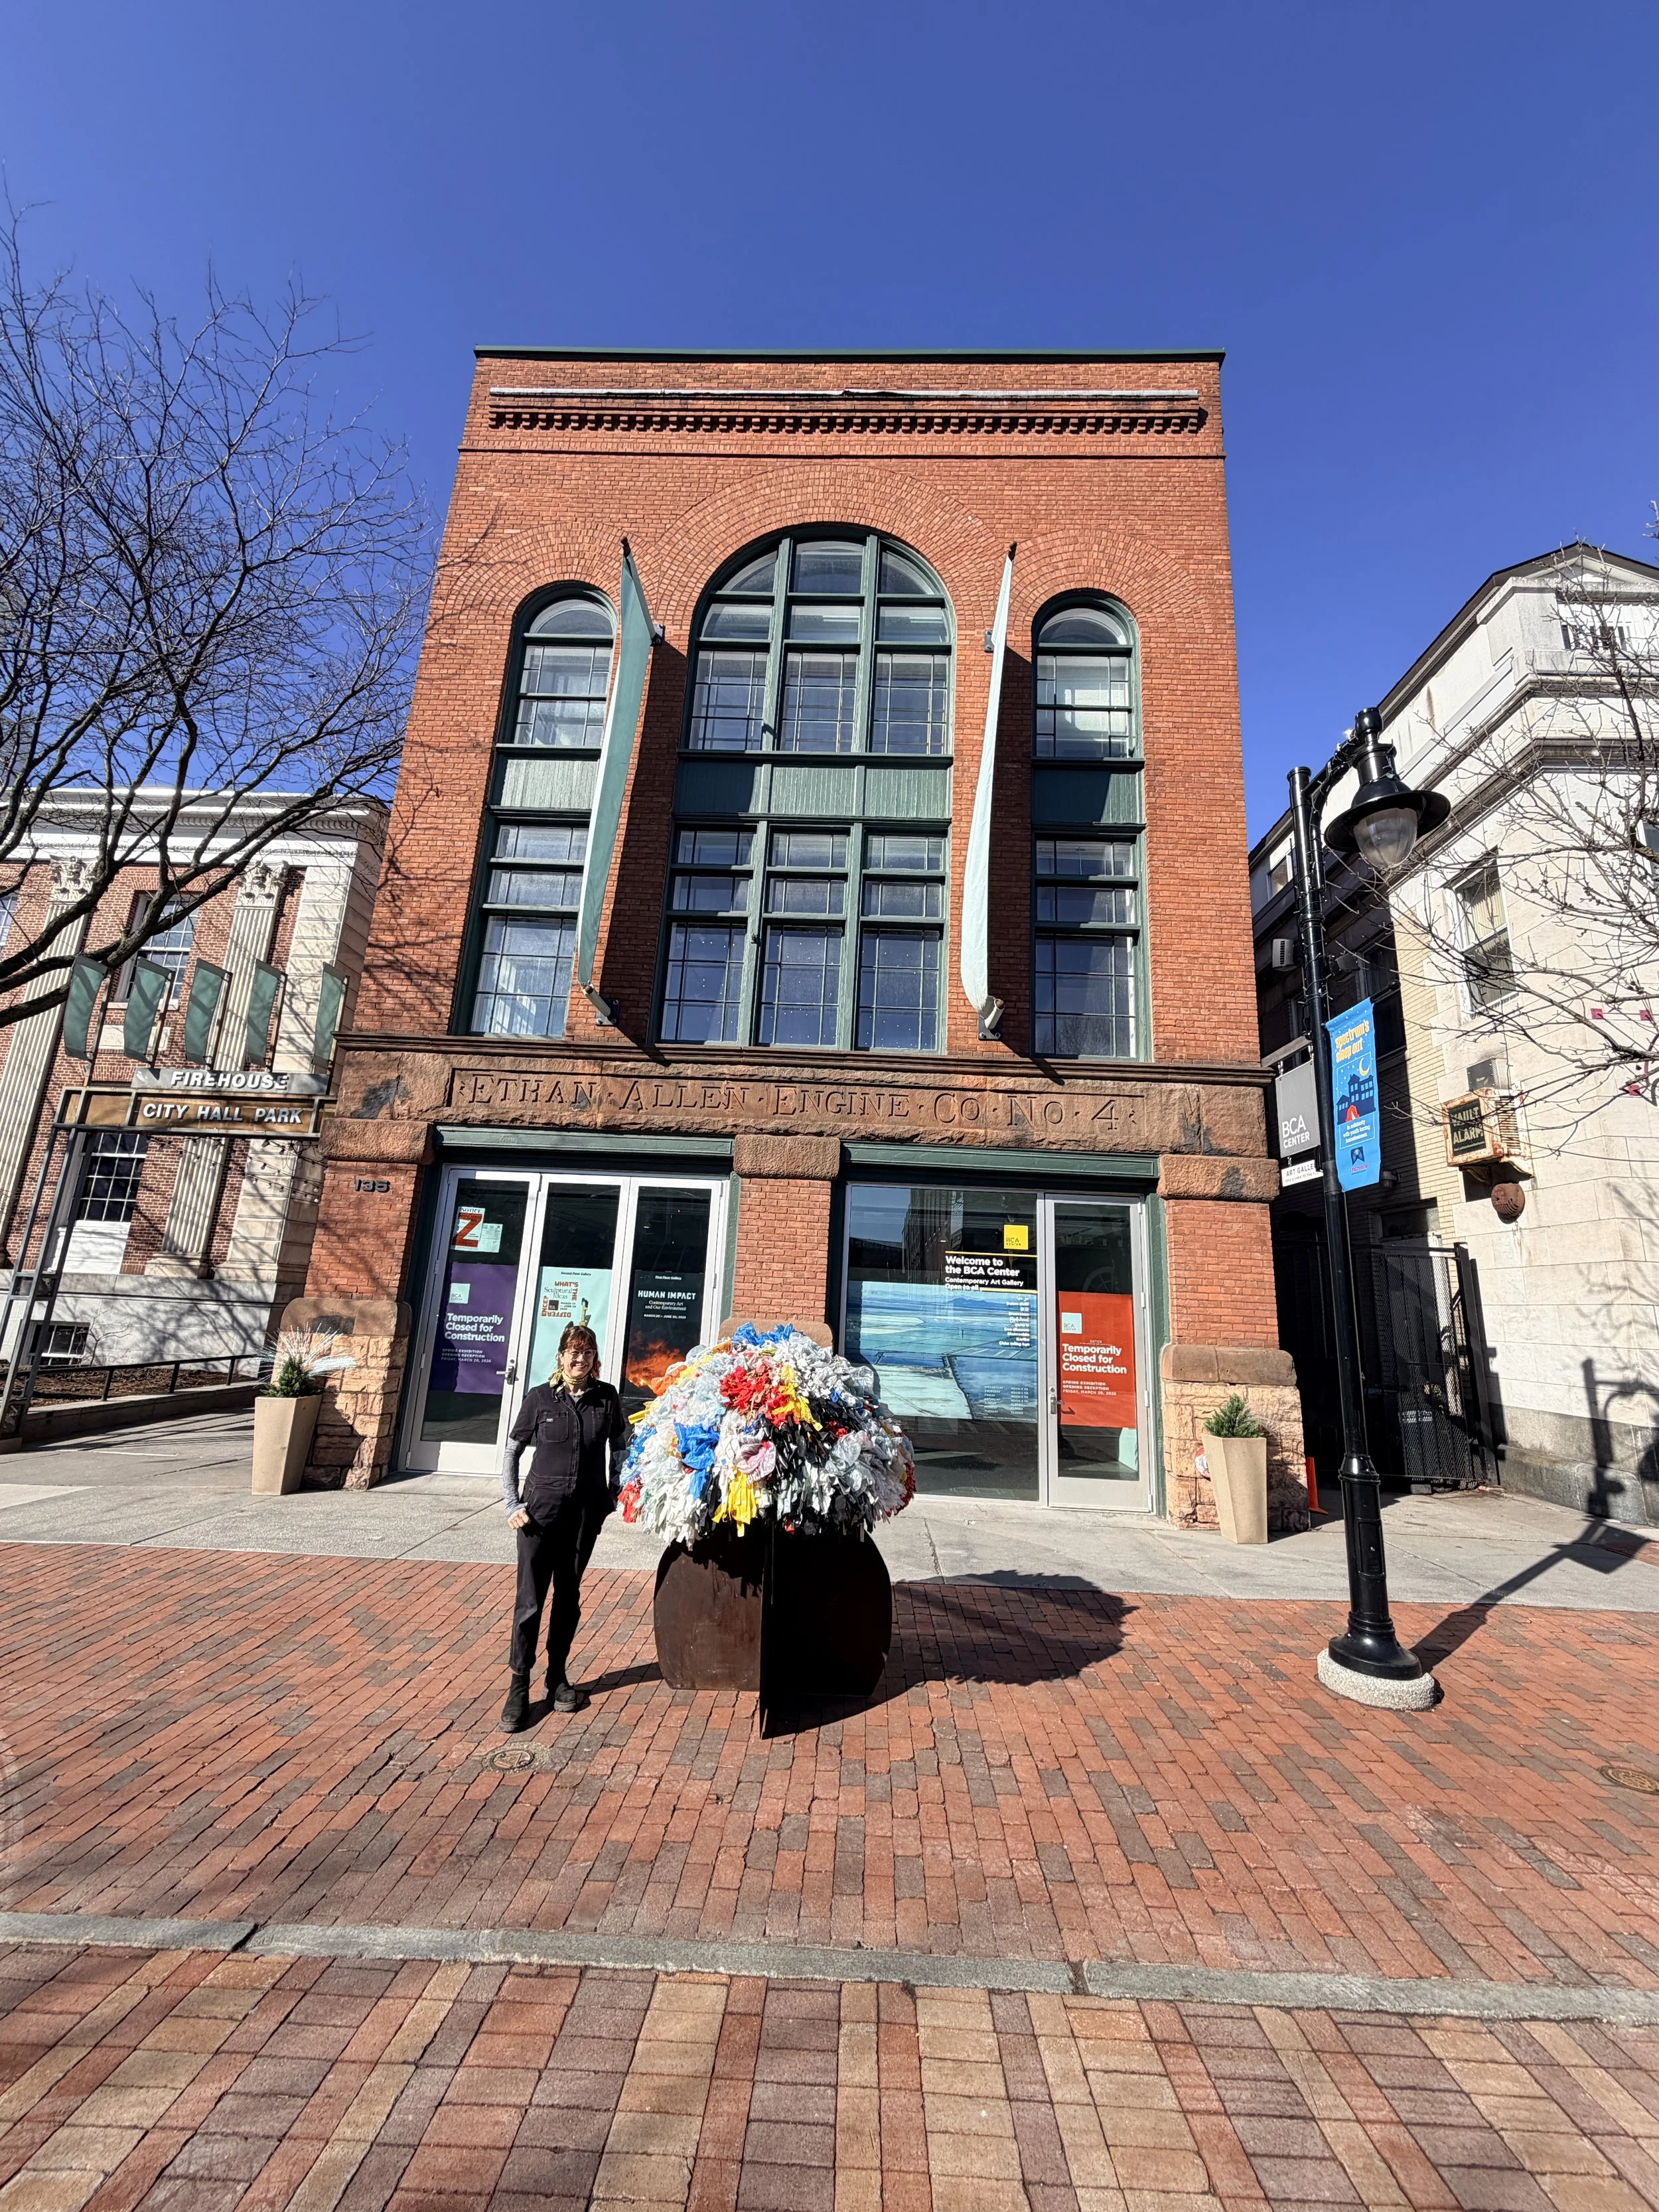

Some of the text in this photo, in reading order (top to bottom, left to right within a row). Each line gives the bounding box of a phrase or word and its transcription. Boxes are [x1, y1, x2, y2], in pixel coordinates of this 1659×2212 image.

[171, 1071, 289, 1090] FIREHOUSE
[468, 1073, 597, 1105] ETHAN
[619, 1080, 750, 1112] ALLEN
[772, 1085, 910, 1118] ENGINE
[1091, 1099, 1119, 1130] 4
[143, 1103, 303, 1124] CITY HALL PARK
[1282, 1114, 1307, 1138] BCA
[1283, 1131, 1310, 1149] CENTER
[1453, 1124, 1484, 1145] ALARM
[1286, 1163, 1314, 1177] ART GALLE
[354, 1179, 390, 1193] 135
[452, 1213, 482, 1248] Z
[946, 1256, 1003, 1266] Welcome to
[945, 1266, 1020, 1277] the BCA Center
[945, 1277, 989, 1286] Contemporary
[447, 1313, 504, 1325] Temporarily
[445, 1322, 494, 1332] Closed for
[445, 1331, 505, 1343] Construction
[1062, 1343, 1122, 1356] Temporarily
[1062, 1353, 1114, 1364] Closed for
[1062, 1363, 1127, 1374] Construction
